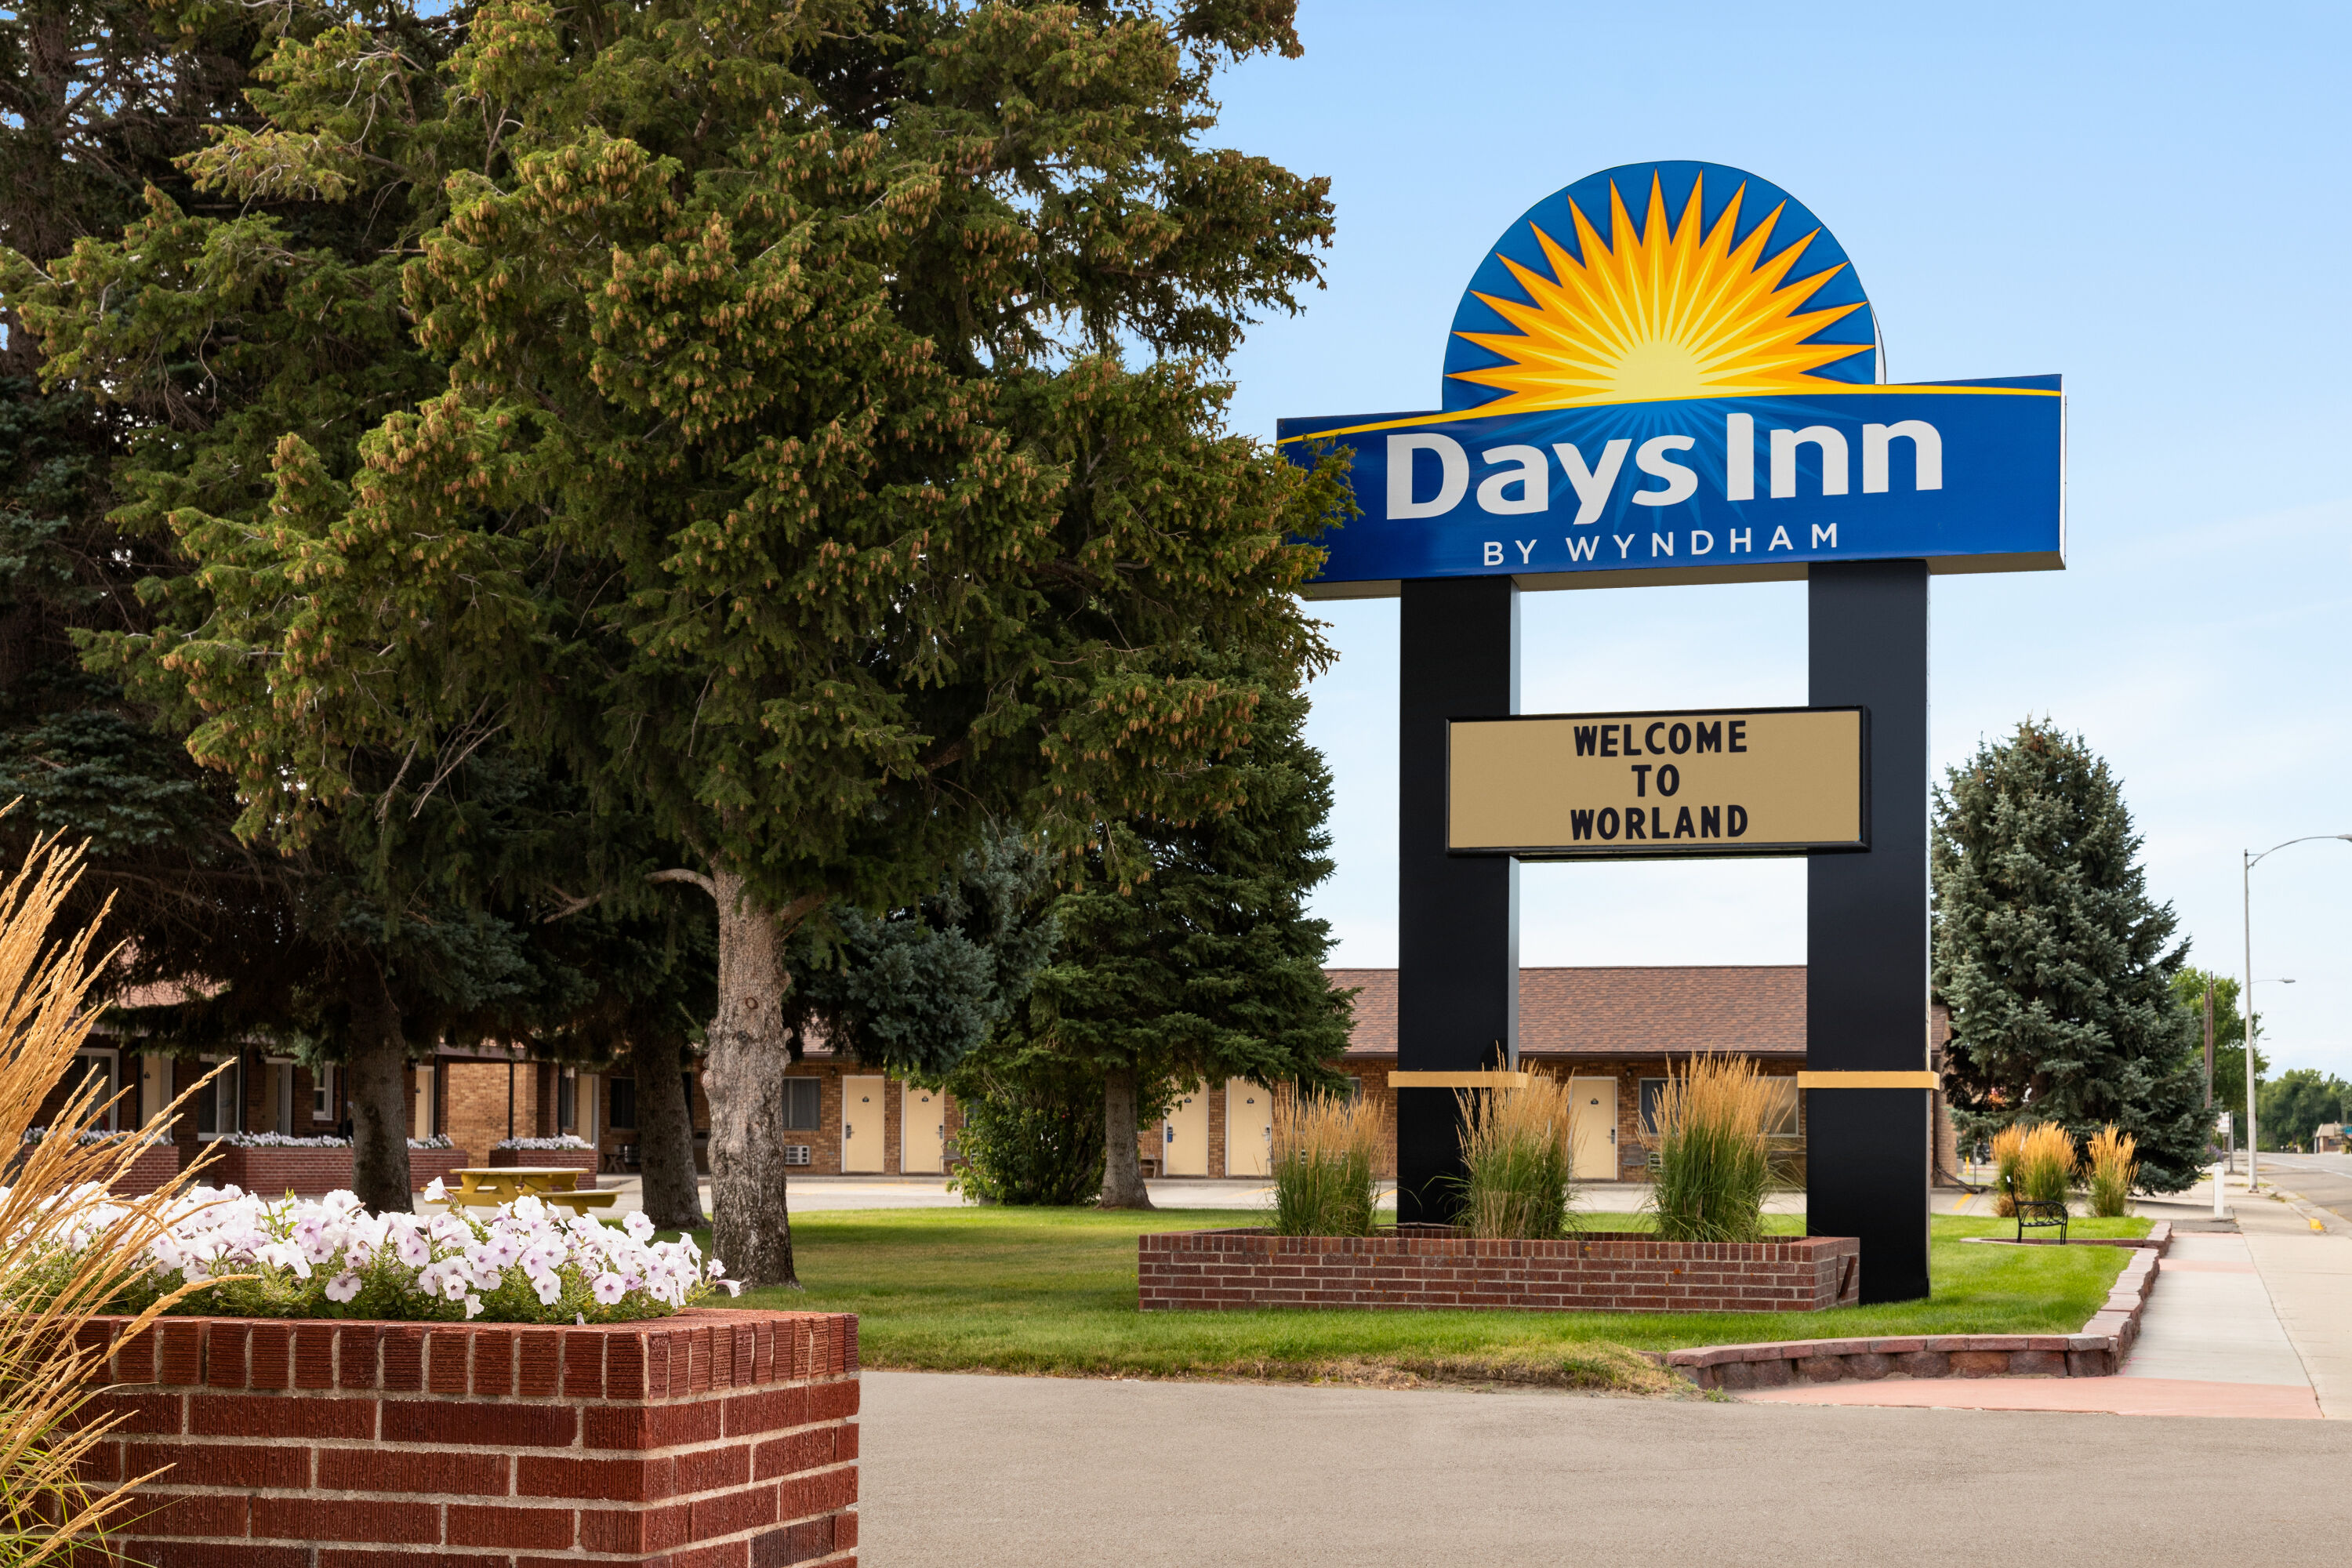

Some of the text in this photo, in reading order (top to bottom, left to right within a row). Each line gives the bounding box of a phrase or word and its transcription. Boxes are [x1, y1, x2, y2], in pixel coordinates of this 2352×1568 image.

[1386, 412, 1943, 525] Days Inn
[1483, 522, 1837, 566] BY WYNDHAM
[1573, 720, 1748, 757] WELCOME
[1631, 764, 1680, 797] TO
[1570, 804, 1748, 841] WORLAND
